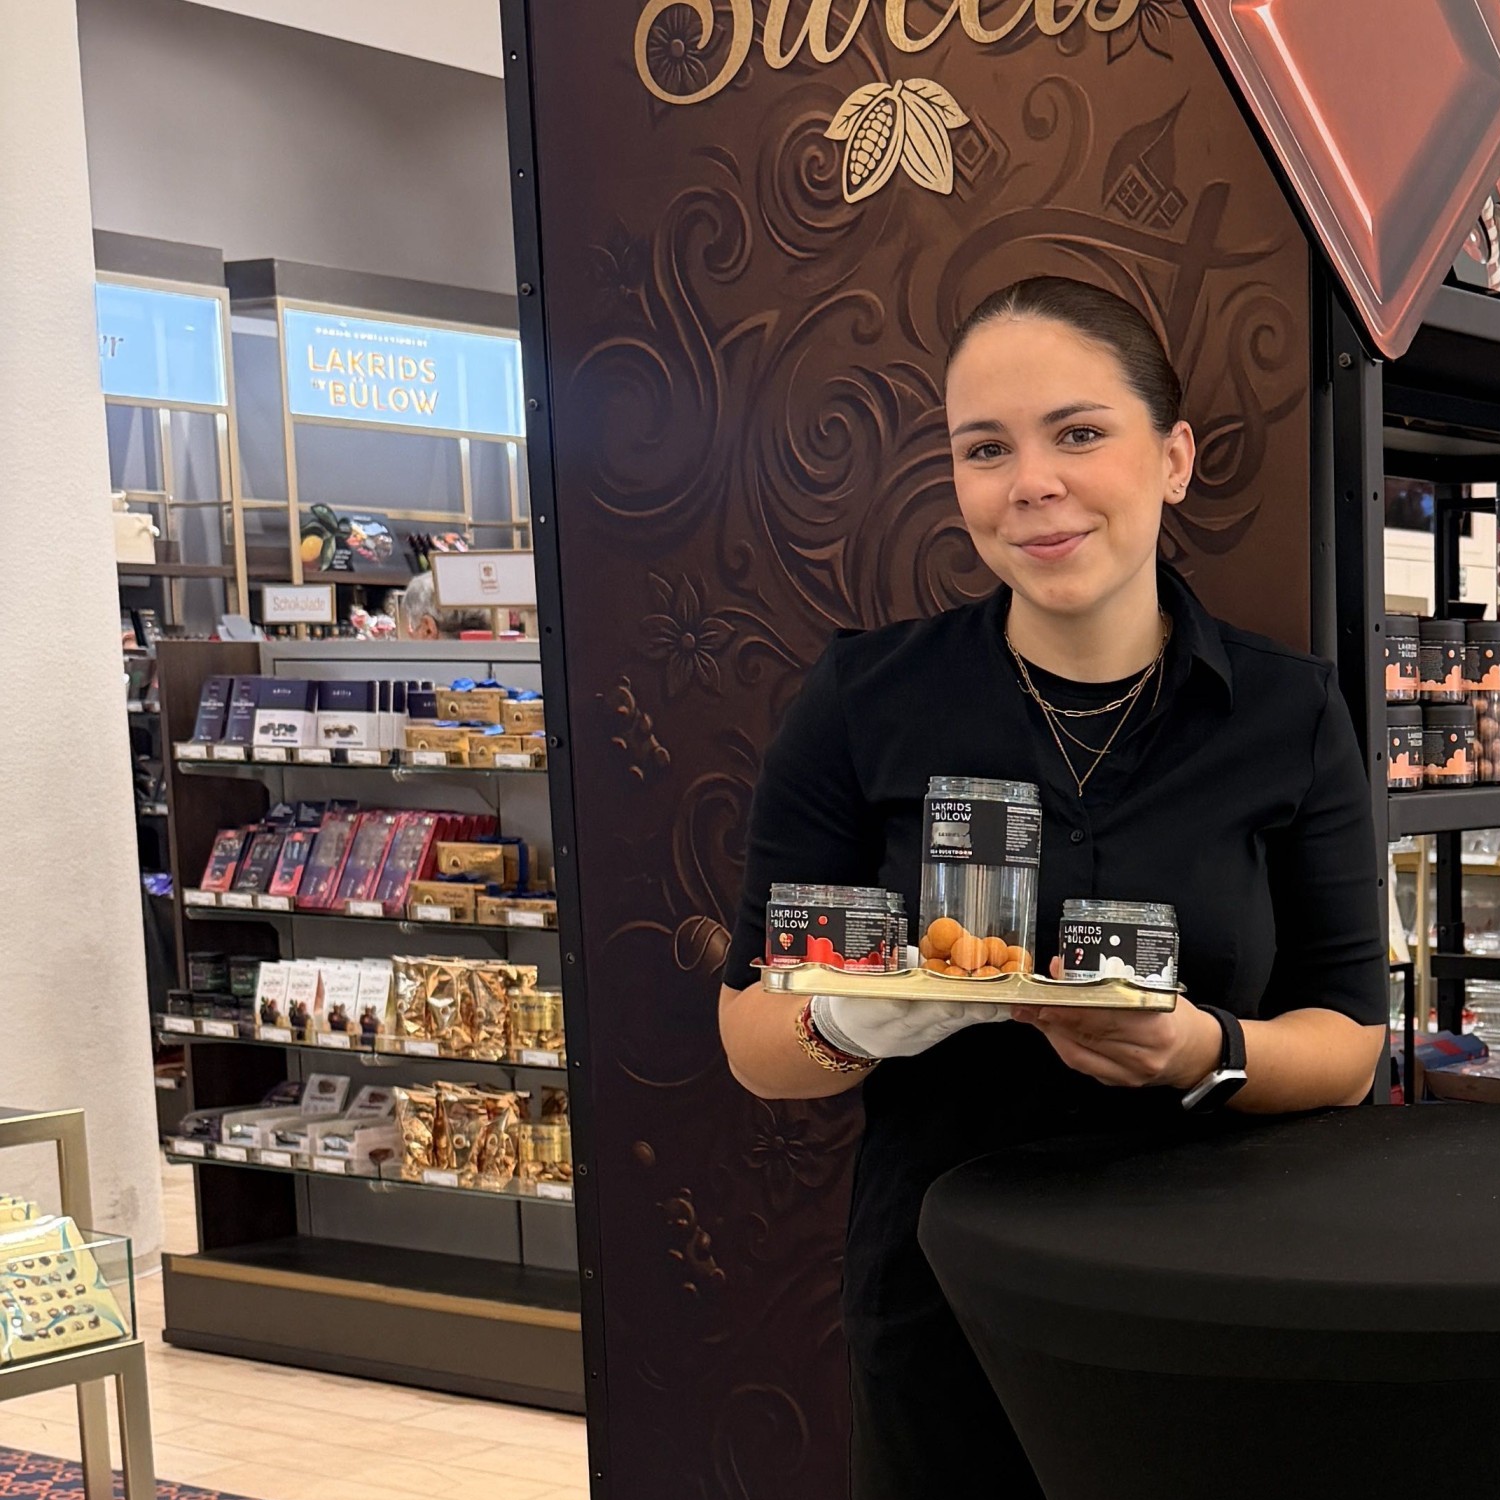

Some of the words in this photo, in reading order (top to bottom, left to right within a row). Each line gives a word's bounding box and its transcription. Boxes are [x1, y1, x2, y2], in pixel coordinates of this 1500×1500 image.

[307, 344, 437, 384] LAKRIDS
[329, 376, 439, 416] BÜLOW
[931, 802, 972, 812] LAKRIDS
[935, 810, 972, 821] BÜLOW
[770, 909, 809, 919] LAKRIDS
[1064, 925, 1102, 935] LAKRIDS
[1067, 933, 1102, 945] BÜLOW
